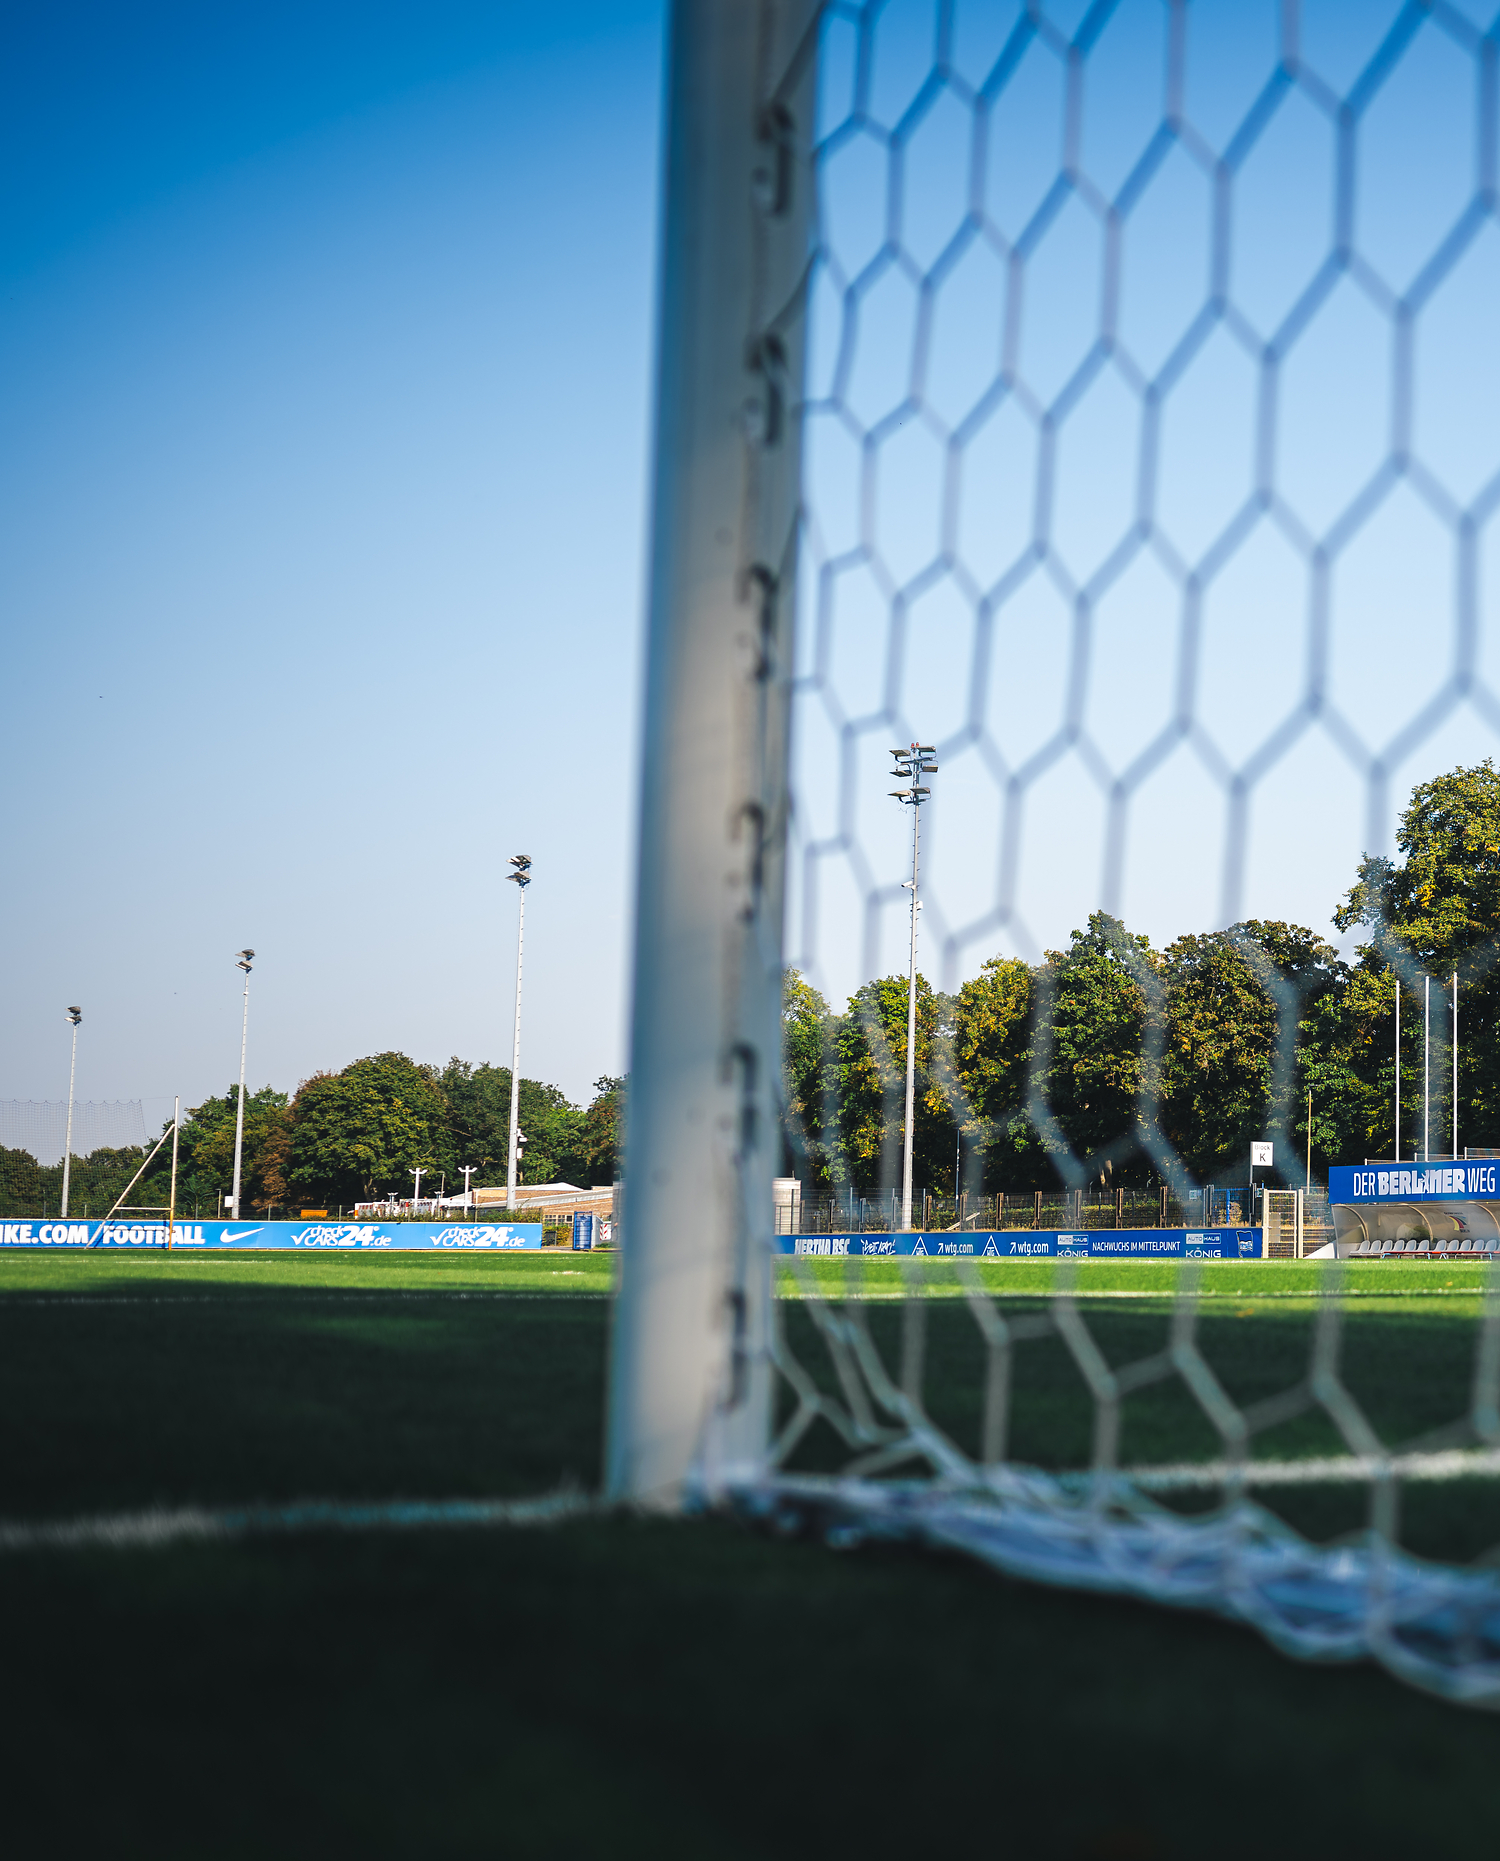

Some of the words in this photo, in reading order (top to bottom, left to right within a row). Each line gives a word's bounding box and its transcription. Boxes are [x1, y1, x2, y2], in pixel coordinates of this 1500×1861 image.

[1260, 1153, 1266, 1162] K
[1353, 1172, 1376, 1196] DER
[1467, 1166, 1496, 1193] WEG
[305, 1235, 338, 1247] CARS
[443, 1235, 475, 1247] CARS
[794, 1238, 831, 1255] HERTHA
[833, 1238, 851, 1255] BSC
[1092, 1241, 1130, 1252] NACHWUCHS
[1131, 1241, 1138, 1251] IM
[1139, 1241, 1181, 1251] MITTELPUNKT
[944, 1241, 974, 1256] wtg.com
[1017, 1241, 1049, 1256] wtg.com
[1057, 1247, 1089, 1257] KÖNIG
[1186, 1246, 1221, 1258] KÖNIG
